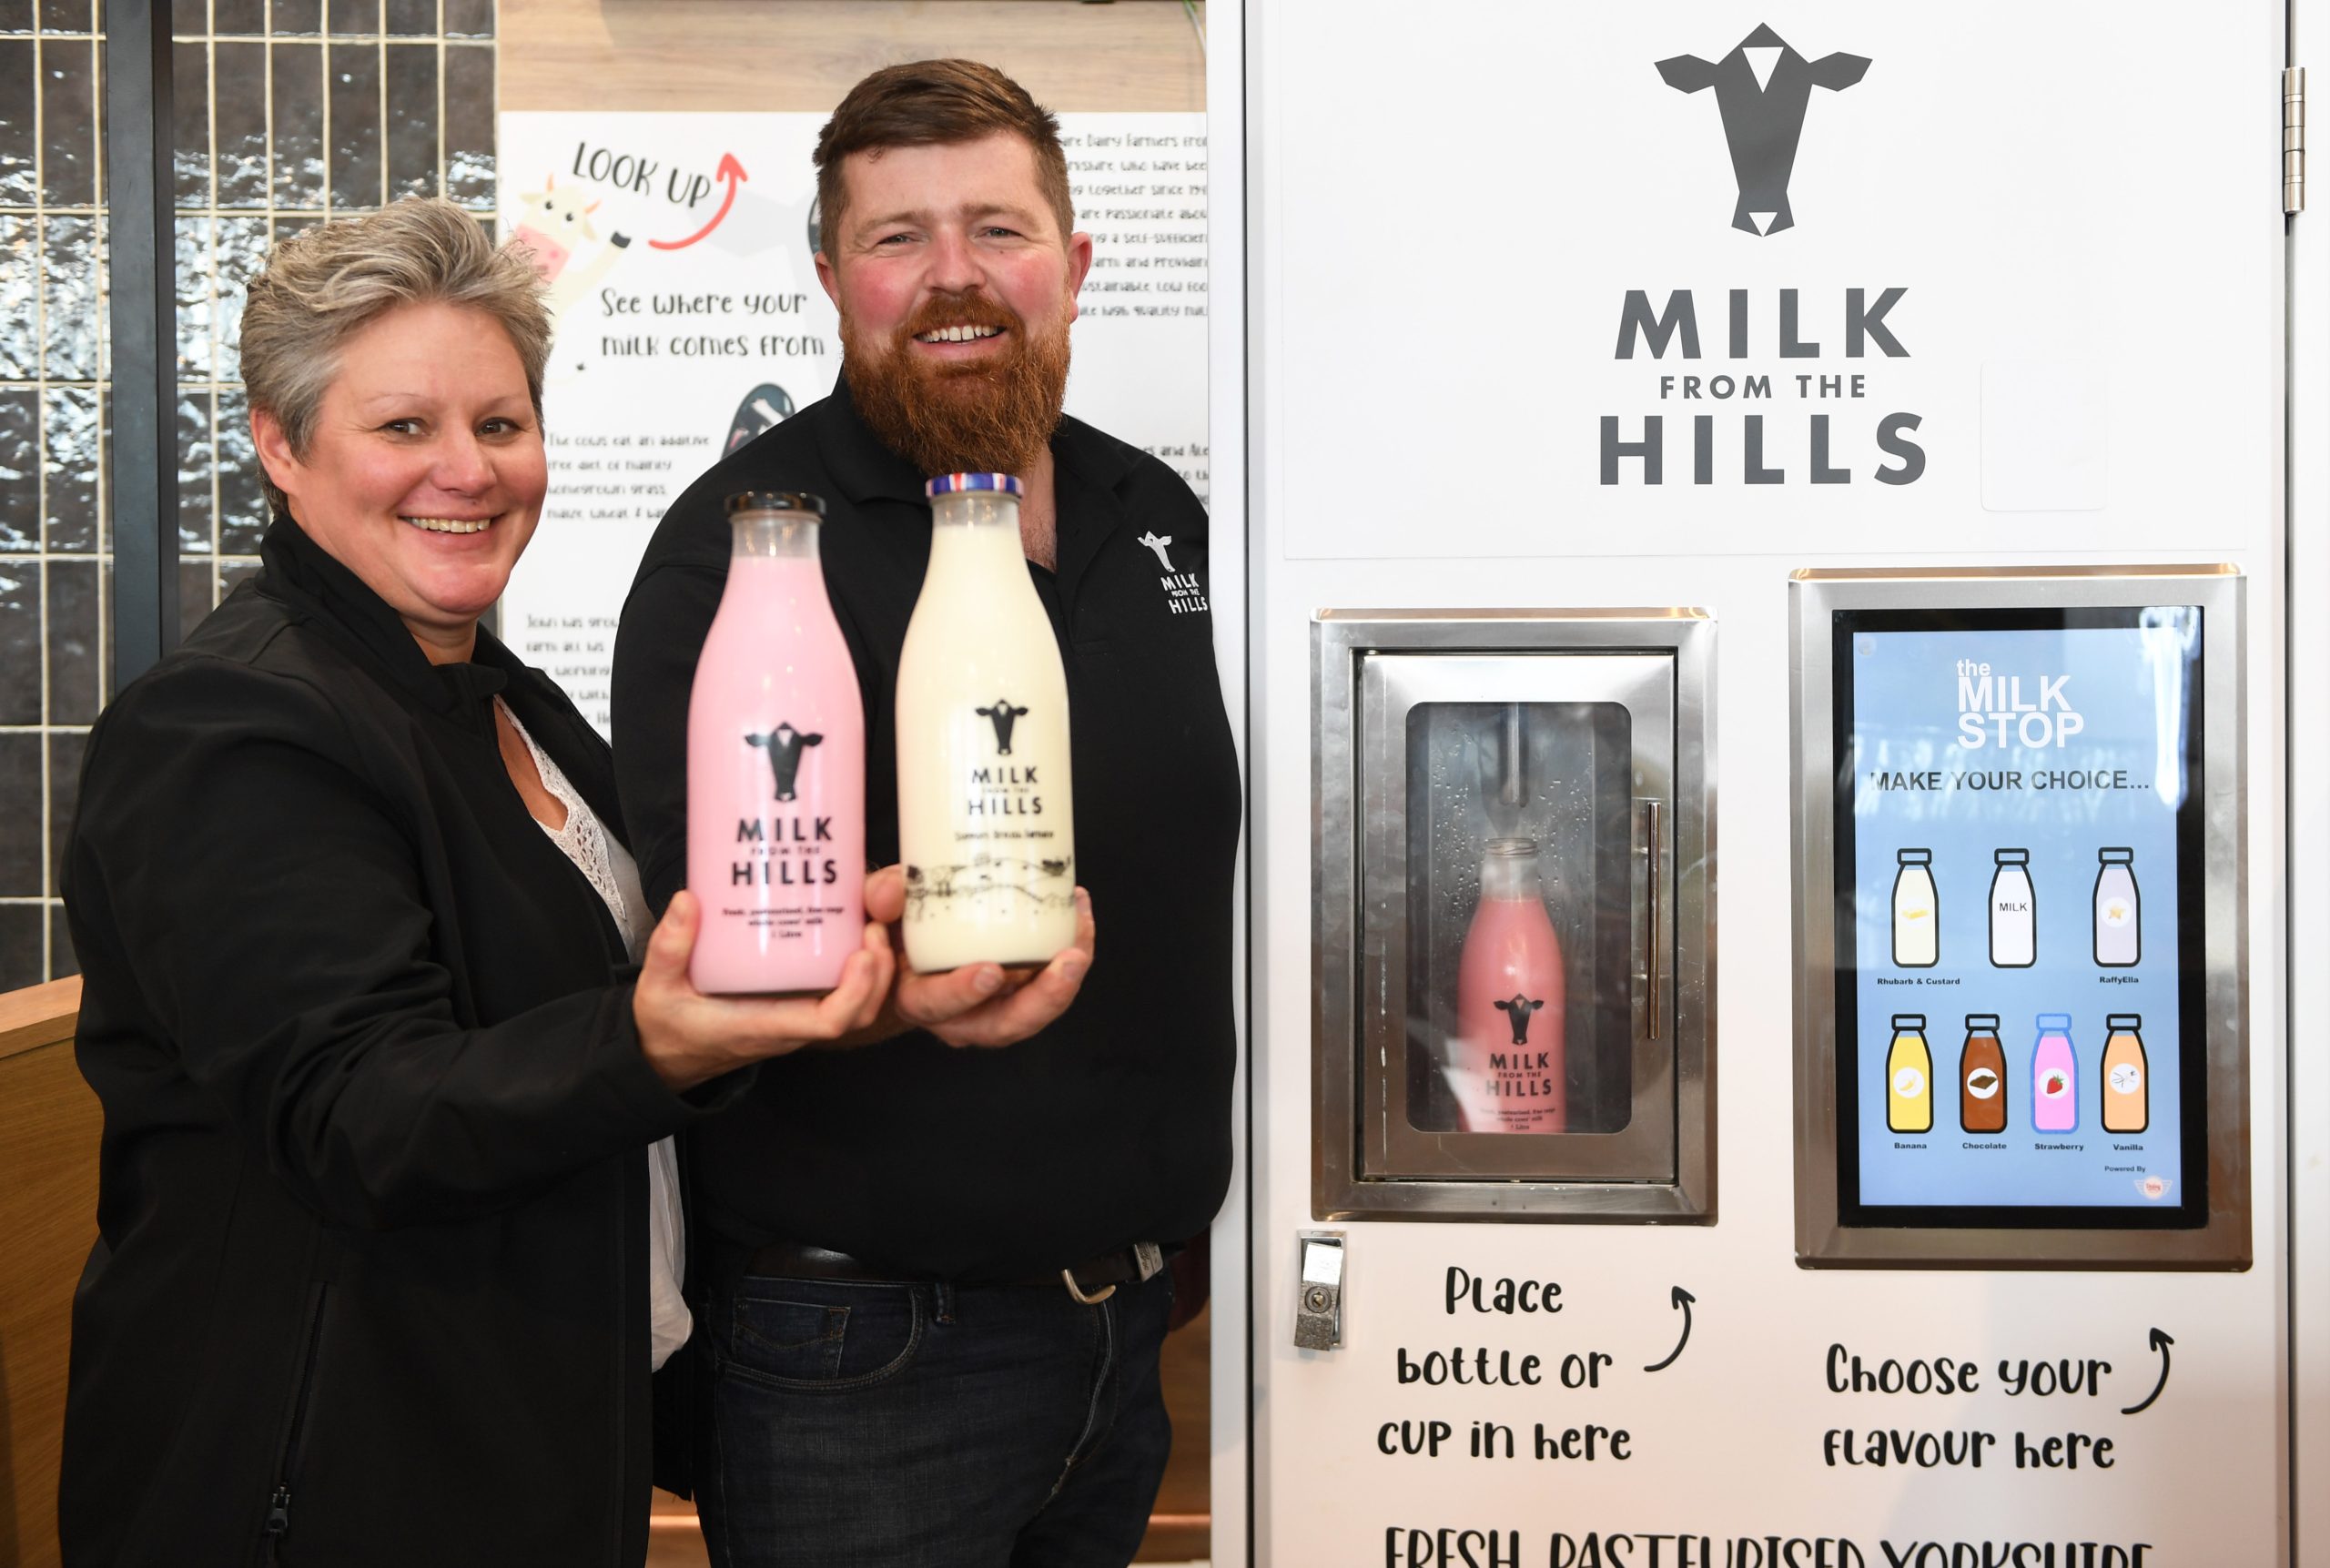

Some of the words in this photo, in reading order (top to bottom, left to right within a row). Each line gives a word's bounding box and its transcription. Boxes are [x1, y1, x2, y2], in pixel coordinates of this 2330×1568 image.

[573, 142, 657, 196] LOOK
[667, 168, 711, 207] UP
[1186, 160, 1207, 171] bee
[601, 288, 641, 316] See
[653, 291, 733, 314] where
[744, 293, 808, 315] your
[1615, 288, 1911, 359] MILK
[602, 336, 659, 356] milk
[670, 336, 748, 356] comes
[760, 335, 825, 356] from
[1660, 375, 1772, 400] FROM
[1796, 374, 1865, 399] THE
[1600, 411, 1926, 486] HILLS
[1160, 573, 1199, 591] MILK
[1169, 596, 1208, 613] HILLS
[1957, 659, 1991, 676] the
[1958, 675, 2072, 712] MILK
[1958, 712, 2084, 749] STOP
[972, 766, 1038, 784] MILK
[1870, 772, 1942, 791] MAKE
[1951, 771, 2022, 790] YOUR
[2031, 770, 2149, 790] CHOICE...
[968, 796, 1042, 815] HILLS
[737, 817, 832, 842] MILK
[732, 860, 837, 885] HILLS
[1999, 903, 2027, 912] MILK
[2099, 976, 2139, 985] RaffyElla
[1489, 1052, 1549, 1070] MILK
[1486, 1078, 1552, 1097] HILLS
[2034, 1143, 2084, 1152] Strawberry
[1445, 1266, 1564, 1315] Place
[1397, 1347, 1543, 1387] bottle
[1561, 1349, 1614, 1388] or
[1825, 1343, 1980, 1395] Choose
[1998, 1357, 2112, 1396] your
[1470, 1420, 1514, 1458] in
[1535, 1423, 1632, 1461] here
[2014, 1432, 2116, 1470] here
[1386, 1527, 1519, 1568] FRESH
